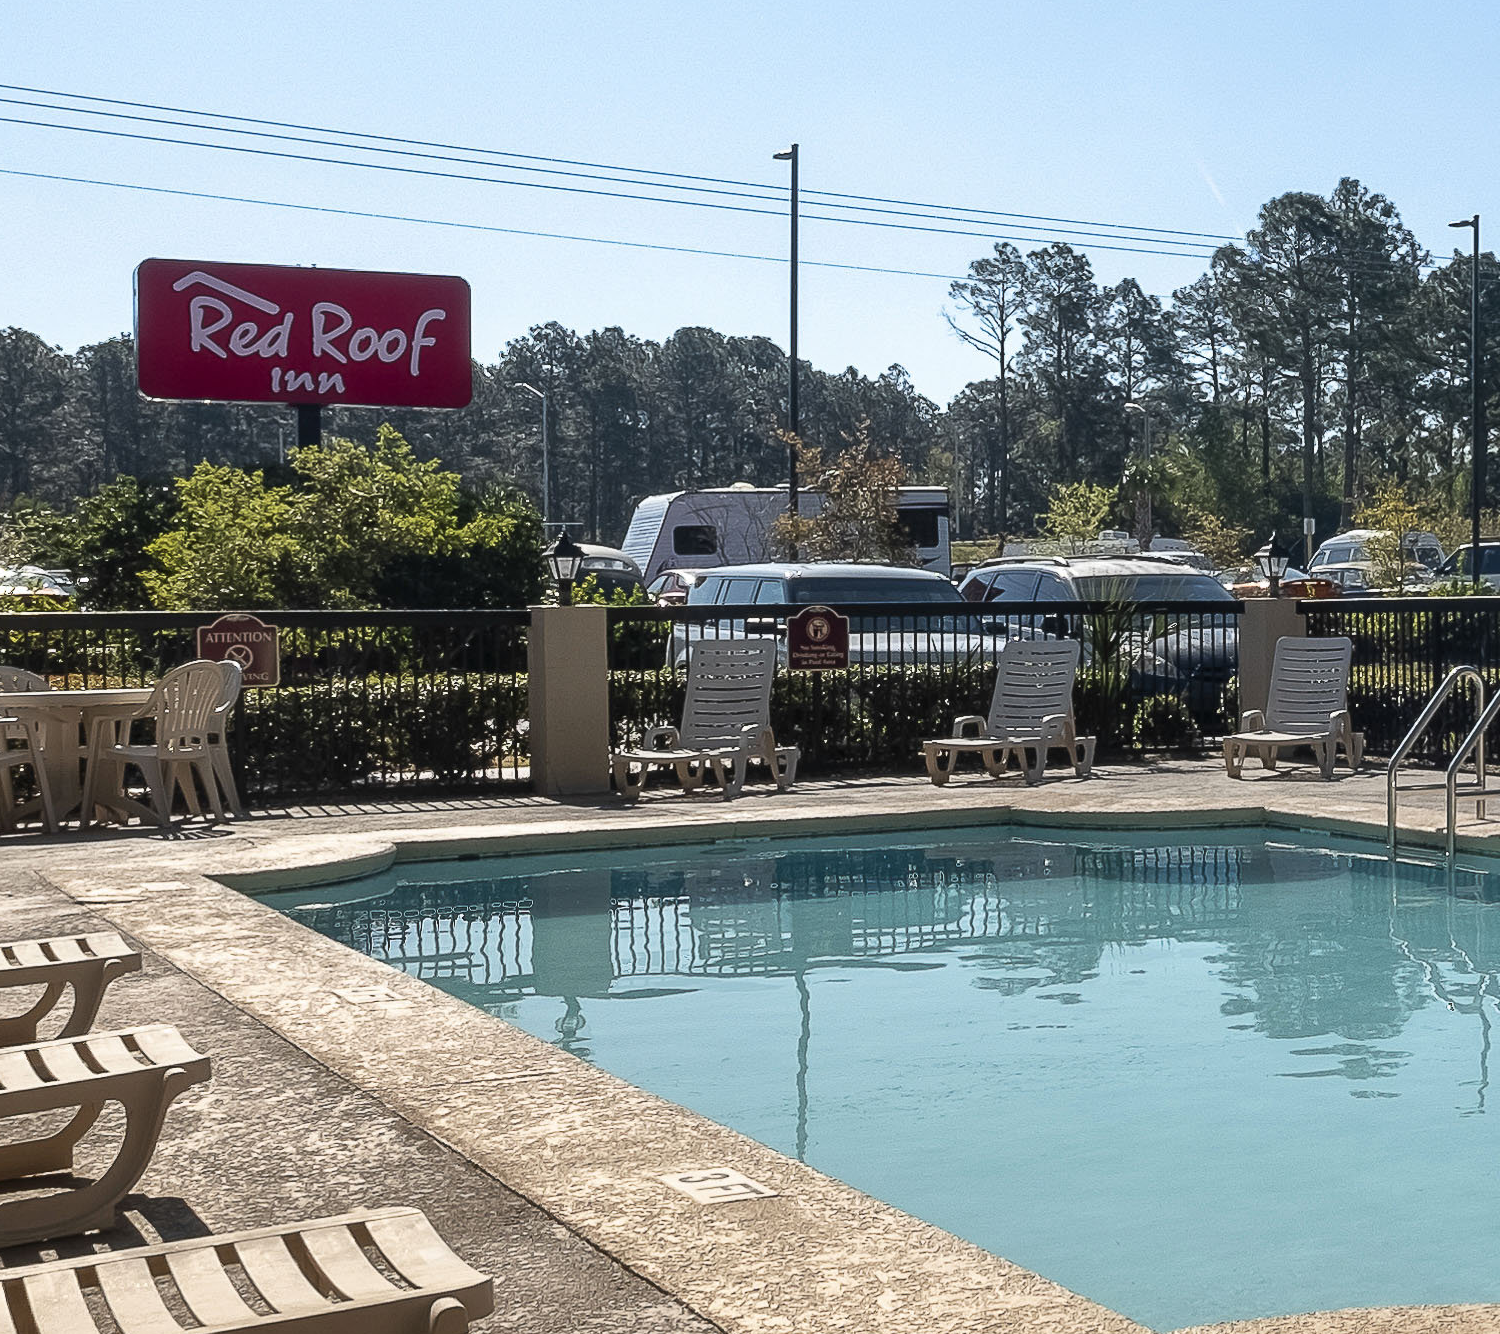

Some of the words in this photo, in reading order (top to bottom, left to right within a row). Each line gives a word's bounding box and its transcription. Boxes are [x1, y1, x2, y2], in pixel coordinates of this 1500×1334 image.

[190, 296, 294, 358] Red
[311, 301, 446, 376] Roof
[205, 631, 272, 643] ATTENTION
[678, 1173, 729, 1183] 3
[696, 1183, 764, 1199] FT
